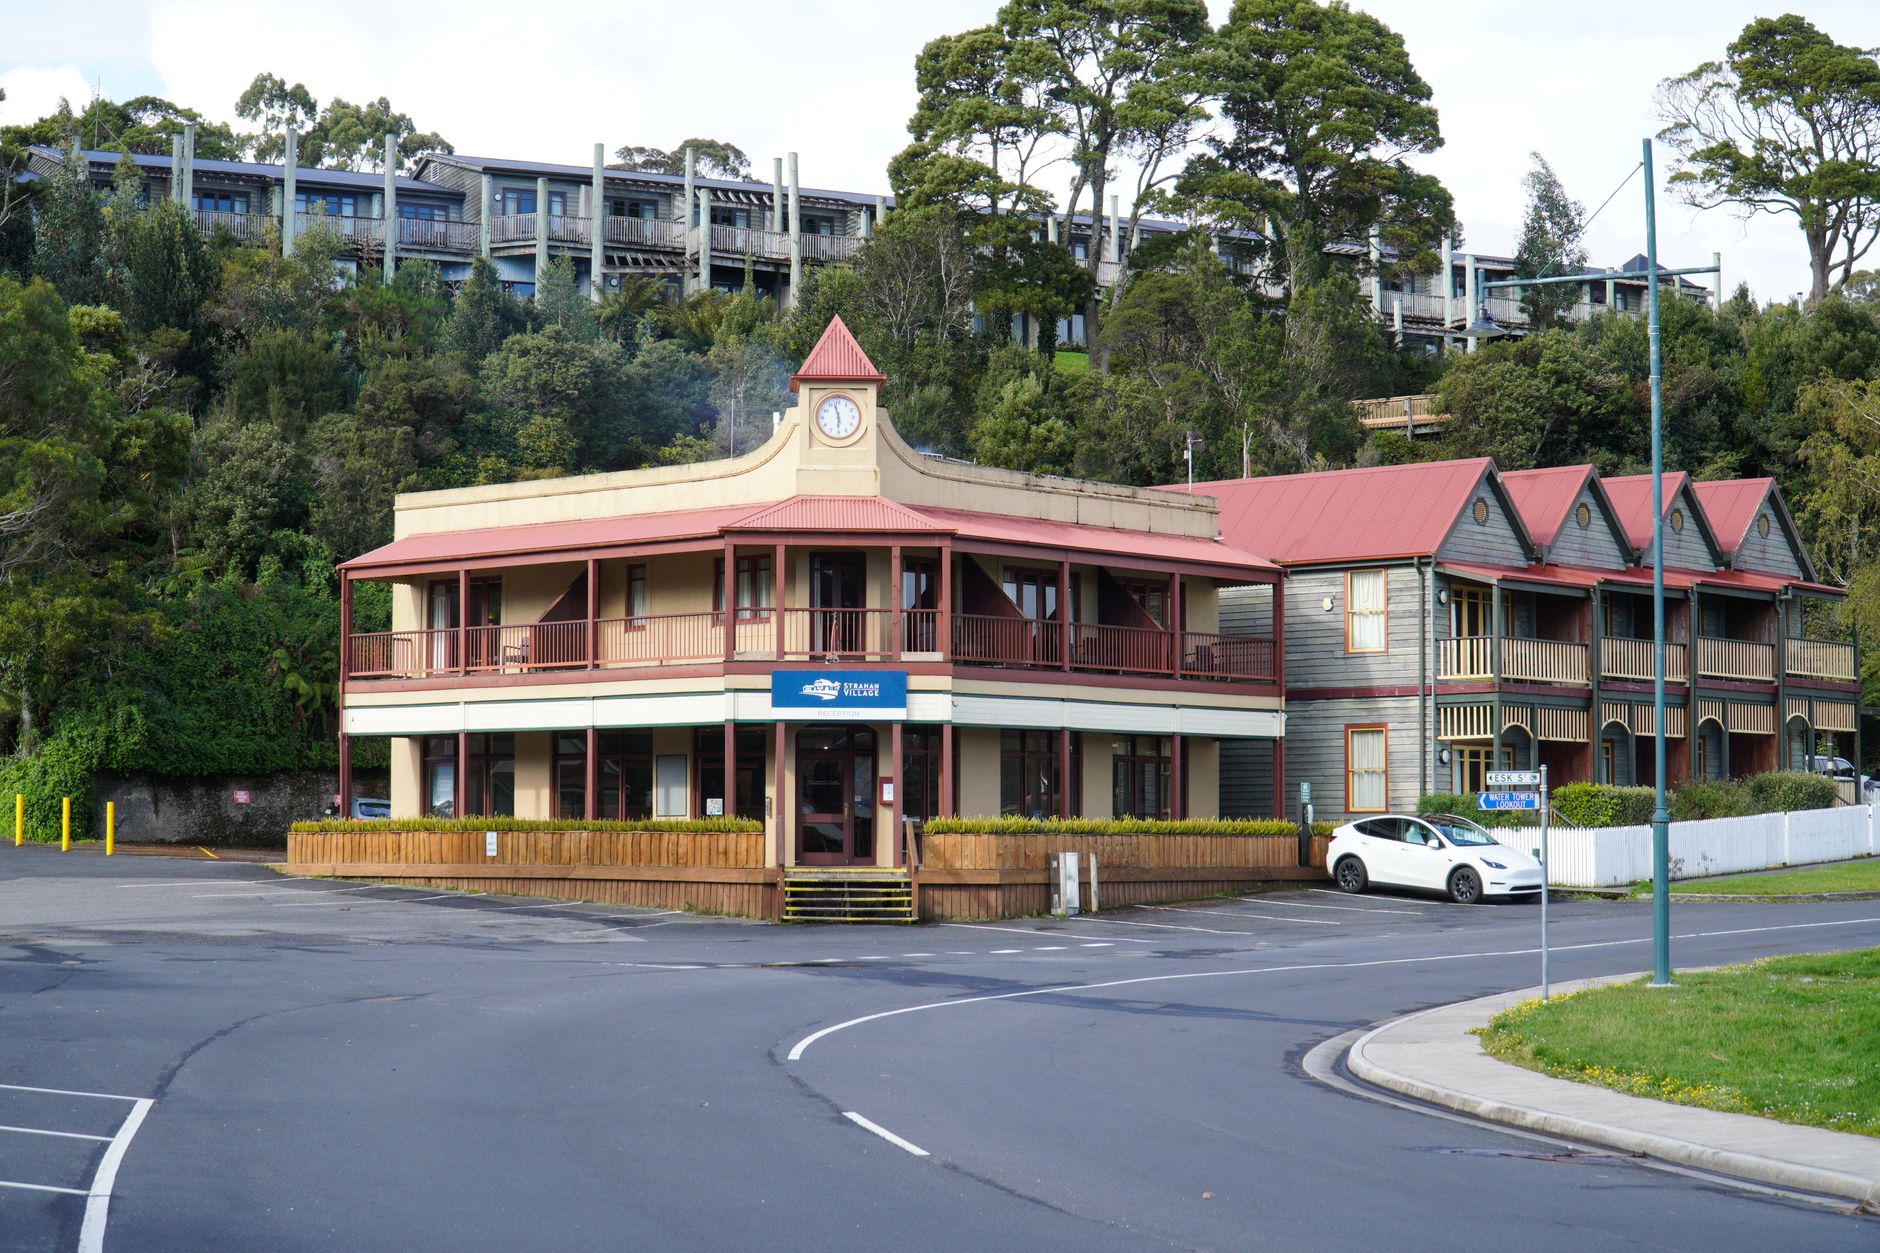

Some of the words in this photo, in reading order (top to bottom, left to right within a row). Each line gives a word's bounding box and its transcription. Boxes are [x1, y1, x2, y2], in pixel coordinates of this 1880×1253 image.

[843, 689, 880, 697] VILLAGE
[1494, 773, 1513, 782] ESK
[1488, 793, 1510, 801] WATER
[1512, 793, 1535, 801] TOWER
